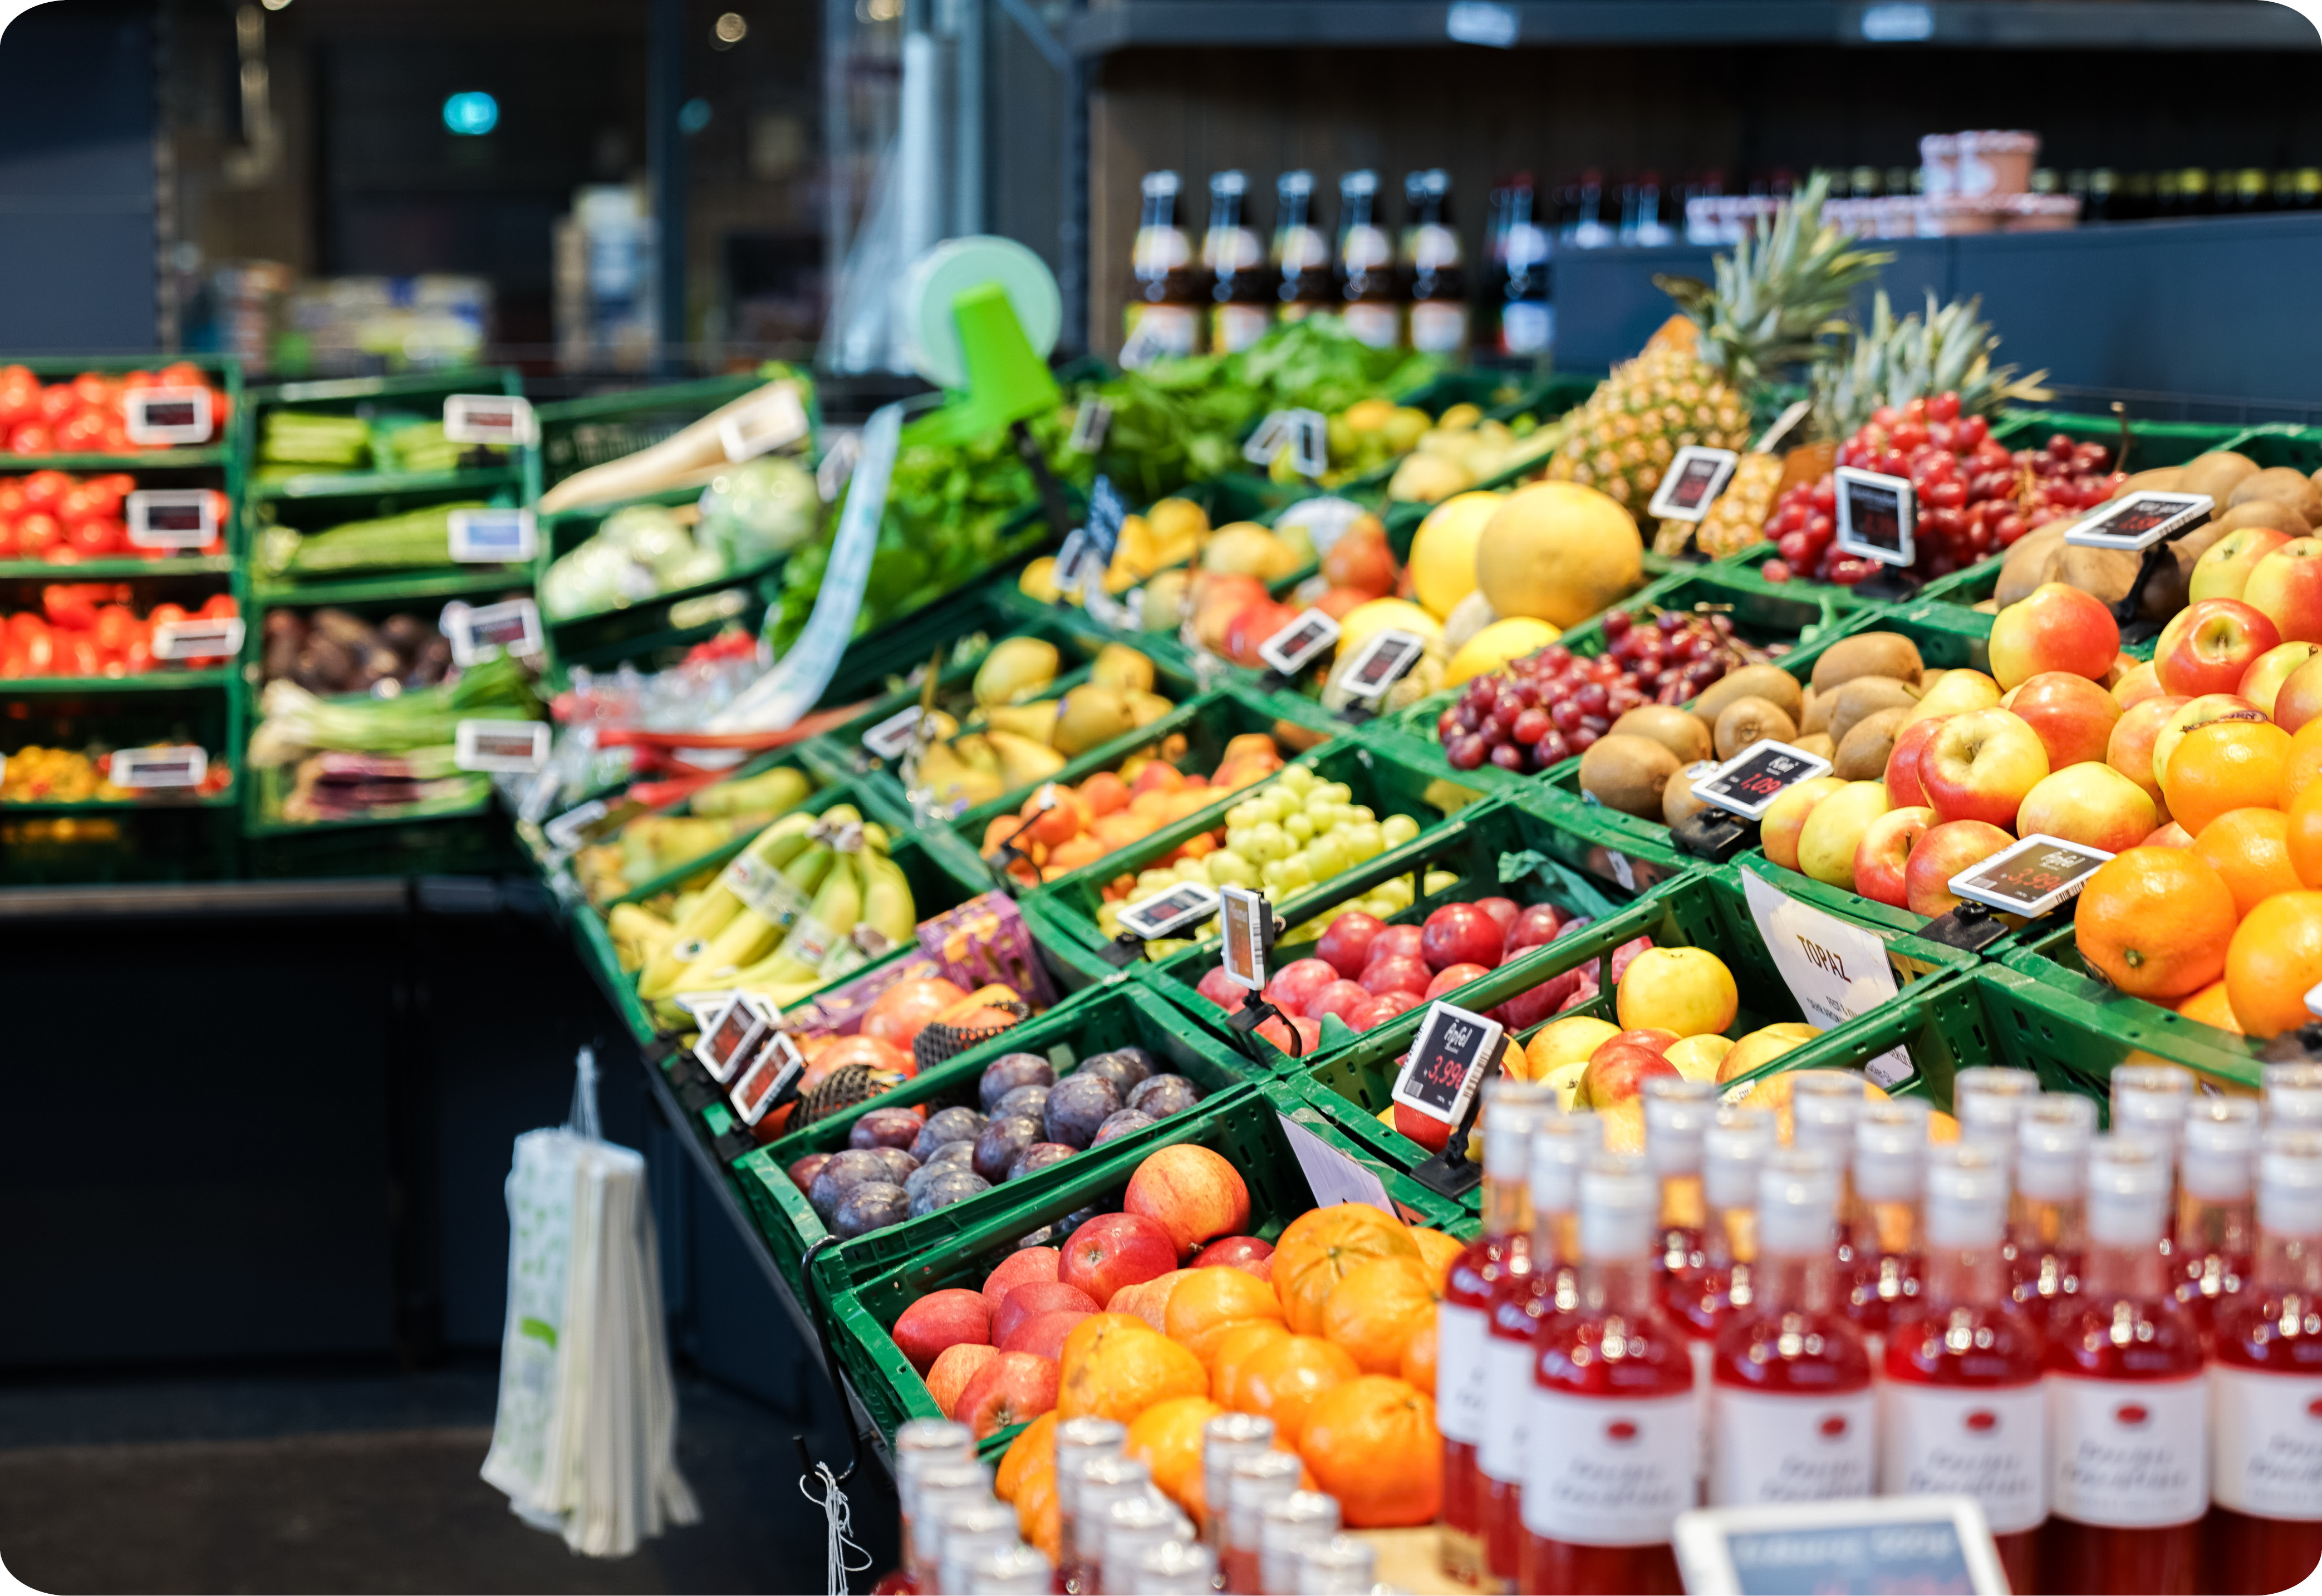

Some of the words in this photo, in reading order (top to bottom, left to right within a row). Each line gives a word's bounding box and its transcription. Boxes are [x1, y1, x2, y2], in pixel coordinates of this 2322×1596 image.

[1741, 773, 1783, 794] 1,09
[1796, 934, 1852, 983] TOPAZ
[1444, 1018, 1473, 1048] Äpfel
